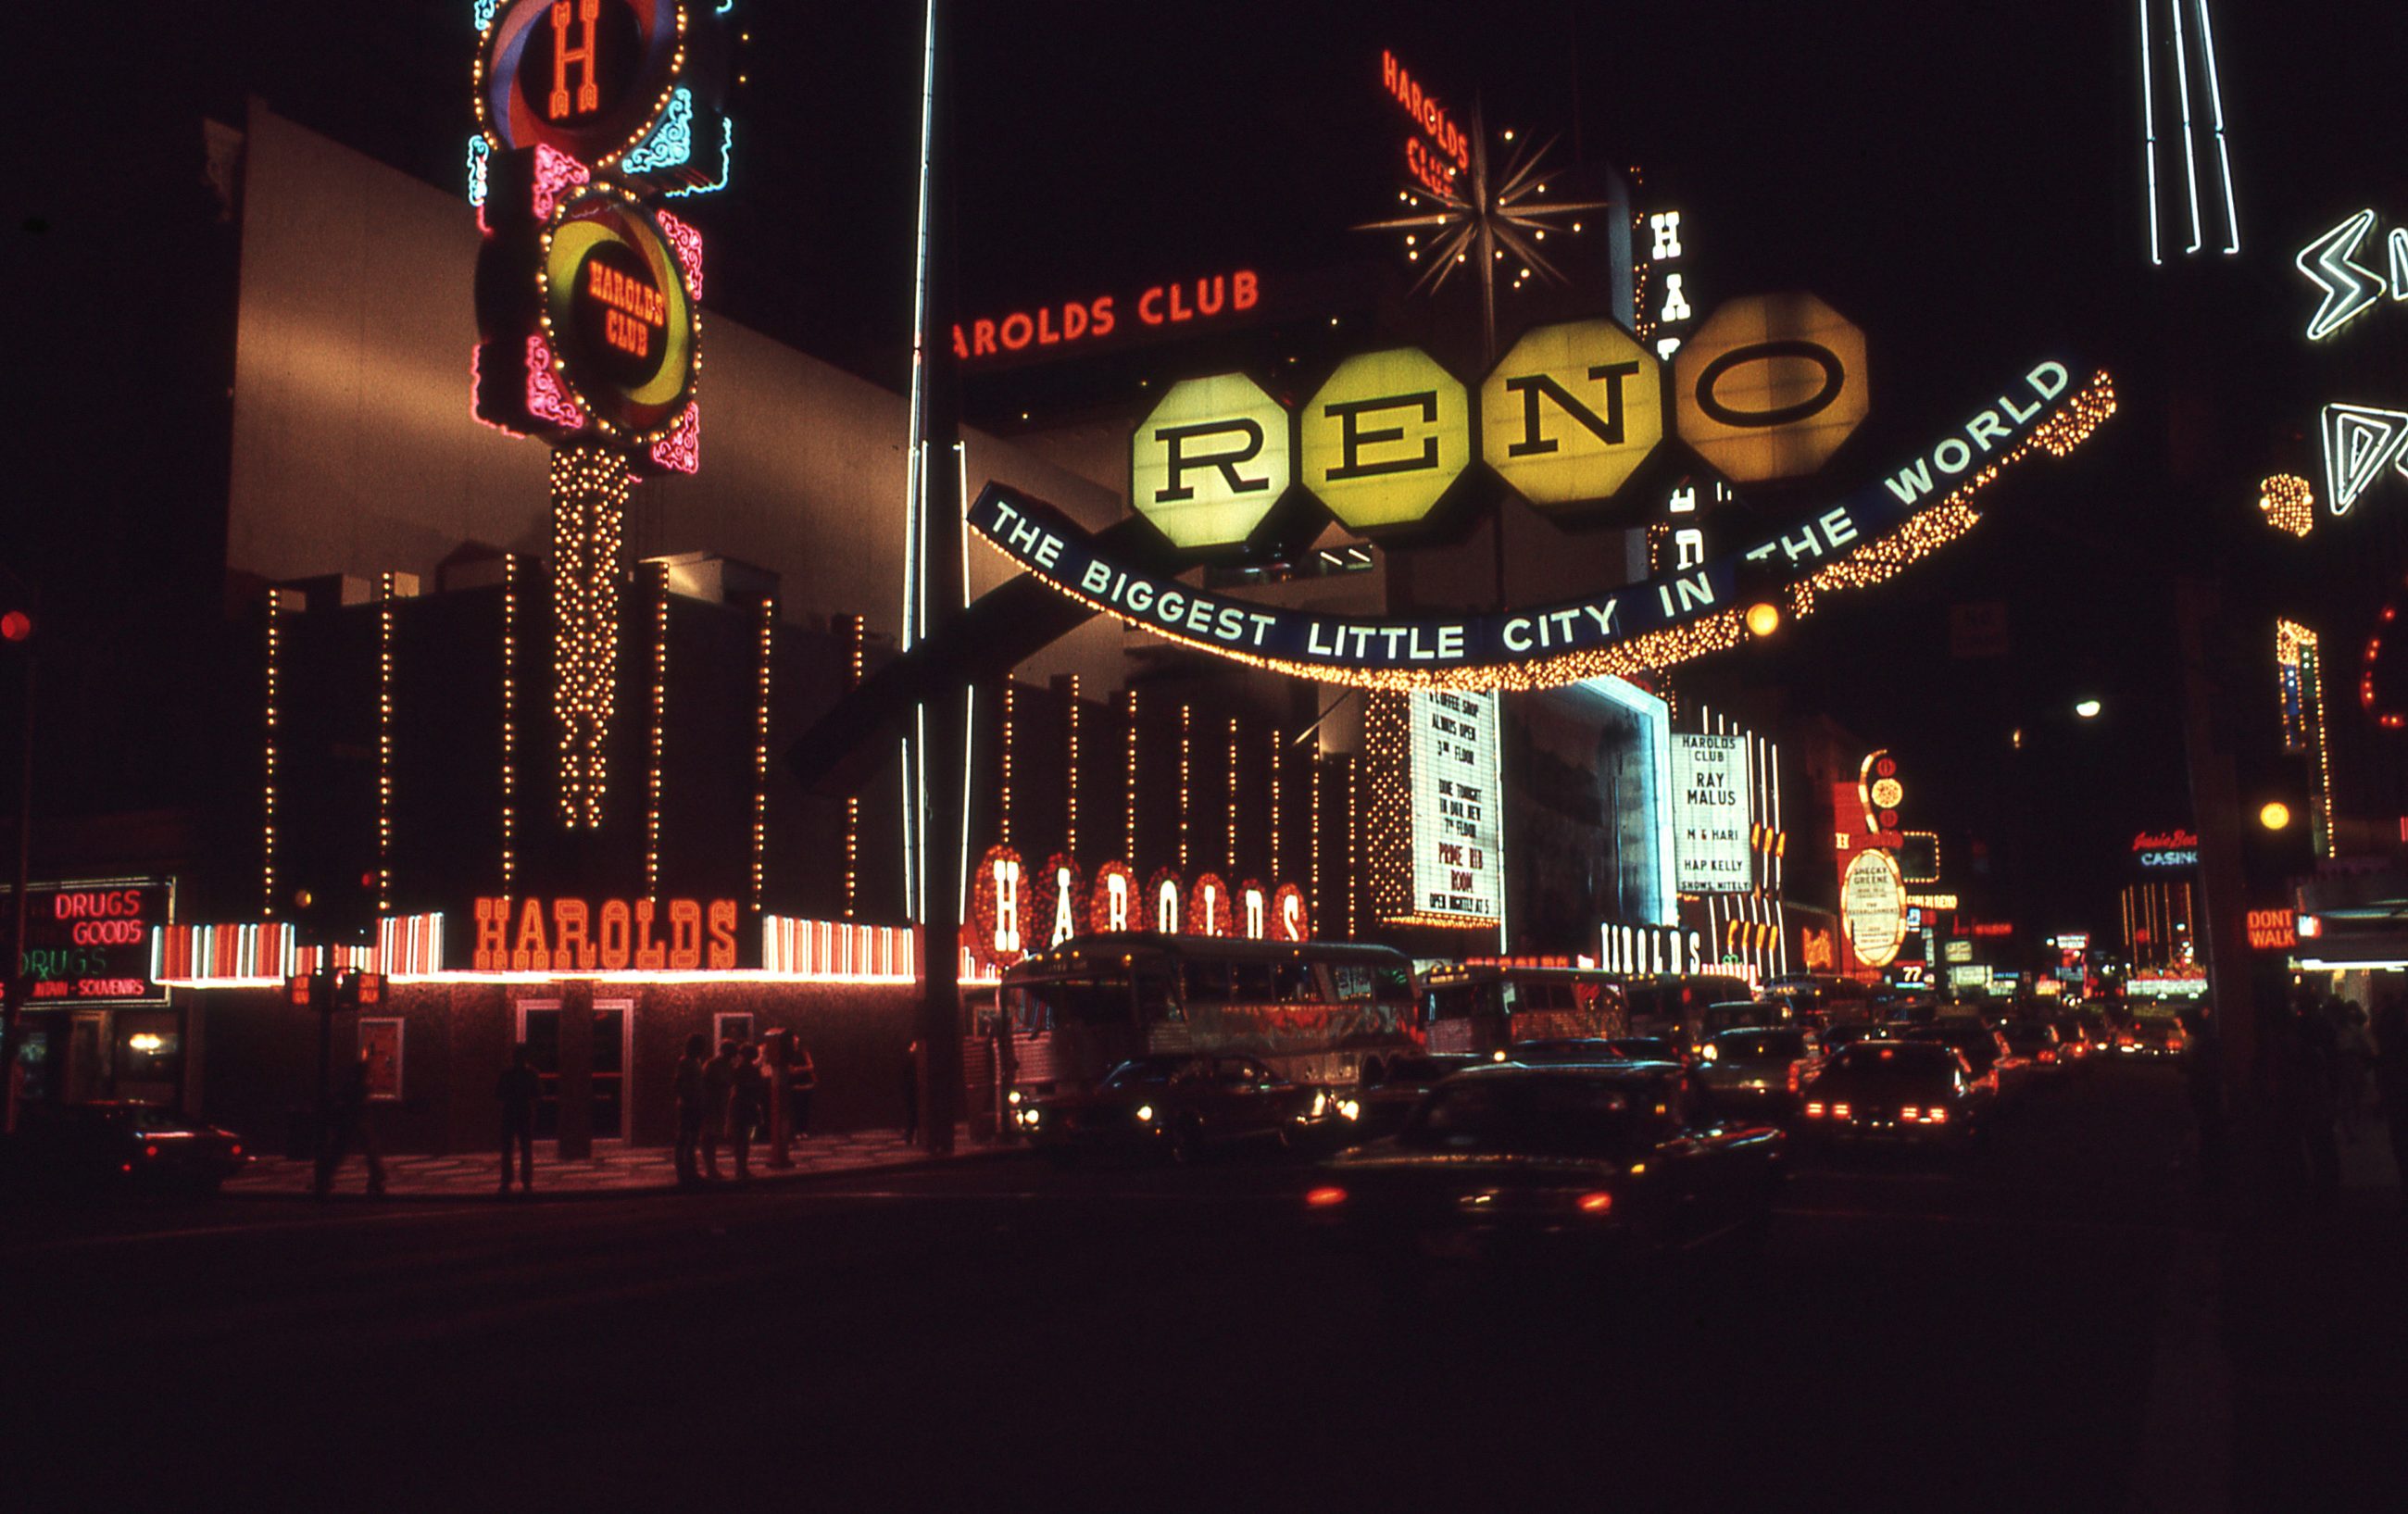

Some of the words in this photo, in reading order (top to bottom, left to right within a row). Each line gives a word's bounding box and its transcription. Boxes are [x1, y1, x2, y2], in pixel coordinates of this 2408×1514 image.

[549, 0, 600, 119] H
[1383, 49, 1469, 175] HAROLDS
[588, 258, 665, 327] HAROLDS
[1138, 269, 1259, 325] CLUB
[606, 307, 648, 357] CLUB
[1154, 340, 1846, 503] RENO
[991, 500, 1065, 569] THE
[1081, 559, 1276, 646] BIGGEST
[1307, 622, 1465, 660] LITTLE
[1503, 598, 1619, 652] CITY
[1659, 571, 1715, 618] IN
[1746, 507, 1858, 568] THE
[1884, 360, 2069, 506] WORLD
[1682, 736, 1737, 749] HAROLDS
[1454, 745, 1474, 766] FLOOR
[1694, 750, 1724, 762] CLUB
[1697, 772, 1724, 787] RAY
[1687, 789, 1737, 806] MALUS
[1456, 820, 1476, 839] FLOOR
[1712, 829, 1738, 840] HARI
[1684, 859, 1707, 870] HAP
[1711, 859, 1743, 871] KELLY
[55, 889, 142, 920] DRUGS
[994, 858, 1298, 953] HAROLDS
[2248, 909, 2293, 927] DONT
[73, 919, 144, 945] GOODS
[473, 896, 737, 970] HAROLDS
[2251, 928, 2296, 948] WALK
[78, 978, 144, 996] SOUVENIRS
